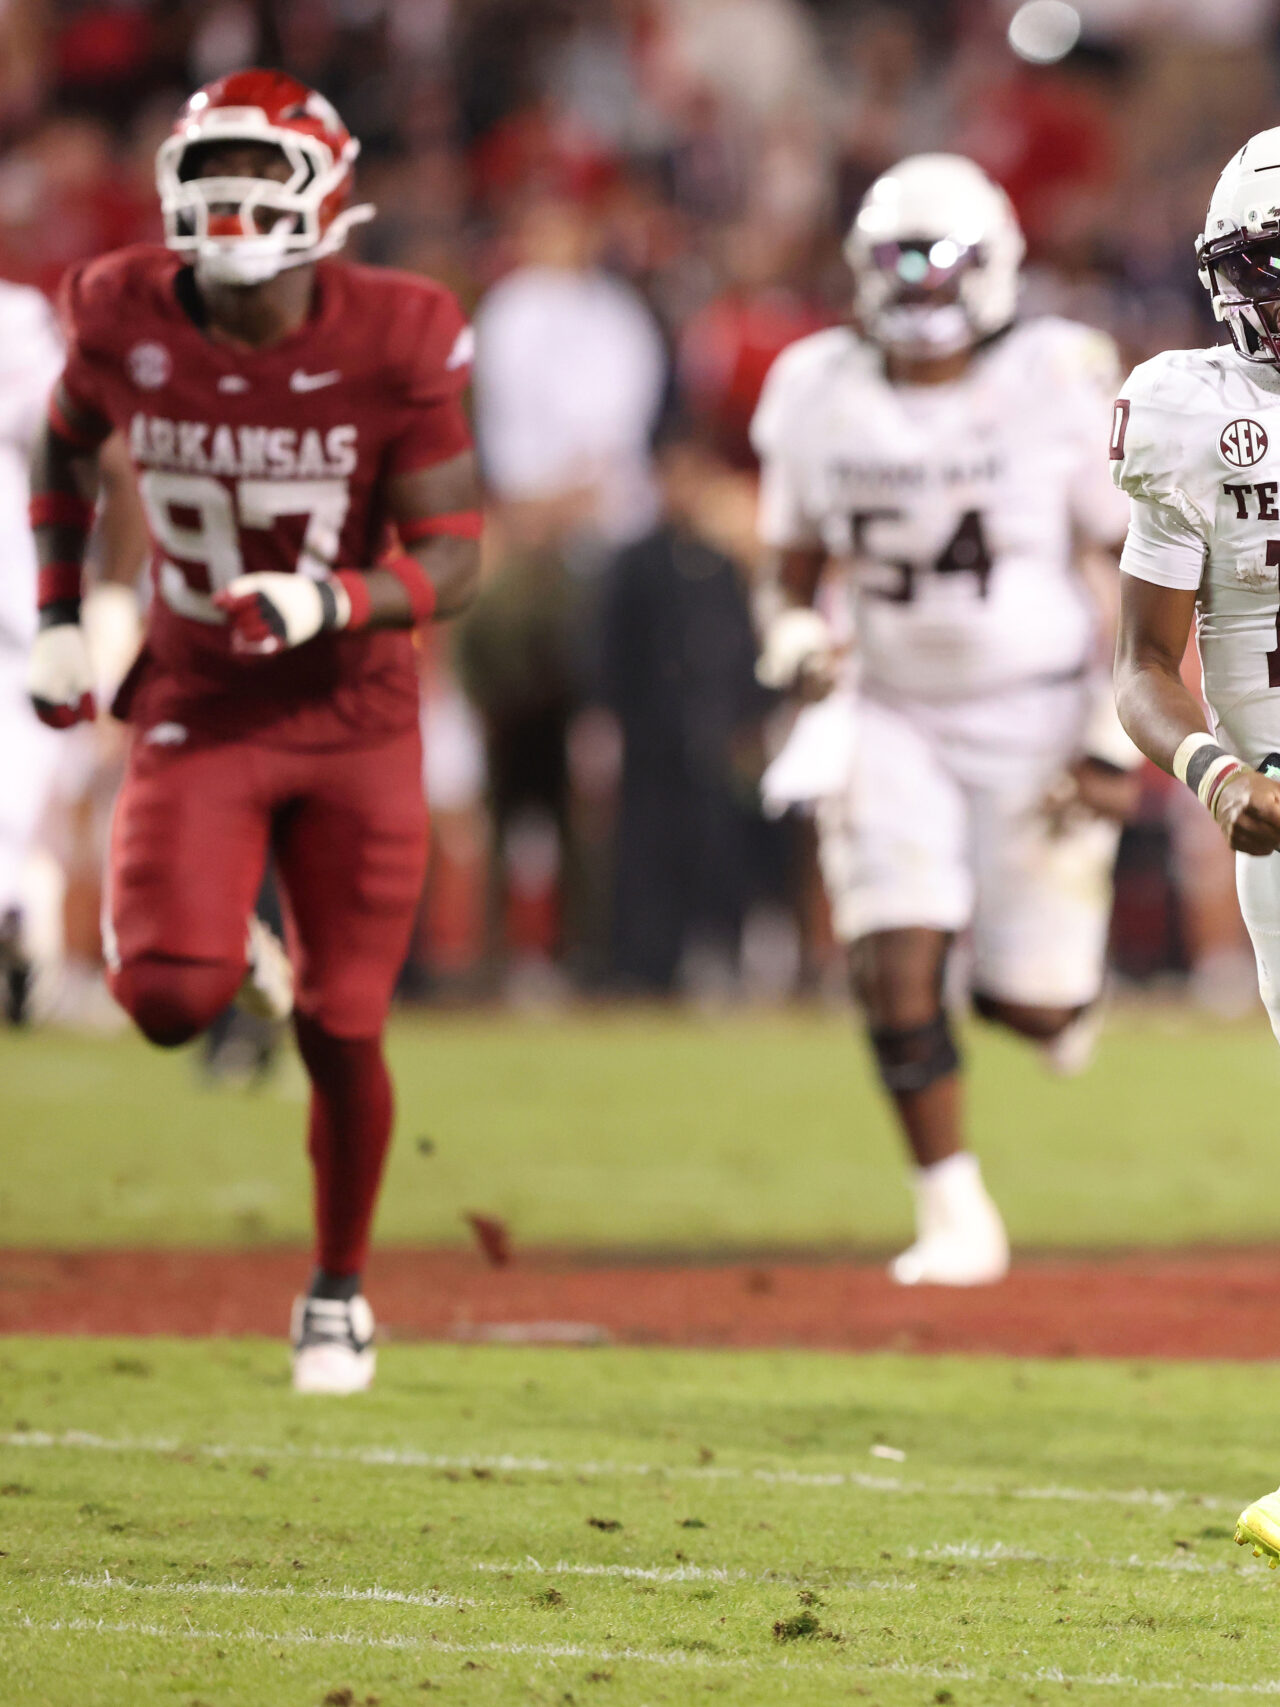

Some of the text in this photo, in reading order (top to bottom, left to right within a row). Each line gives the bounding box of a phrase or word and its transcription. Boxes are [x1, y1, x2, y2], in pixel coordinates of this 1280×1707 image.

[129, 411, 358, 477] ARKANSAS
[1220, 419, 1267, 467] SEC
[138, 471, 350, 625] 97
[850, 507, 993, 604] 54
